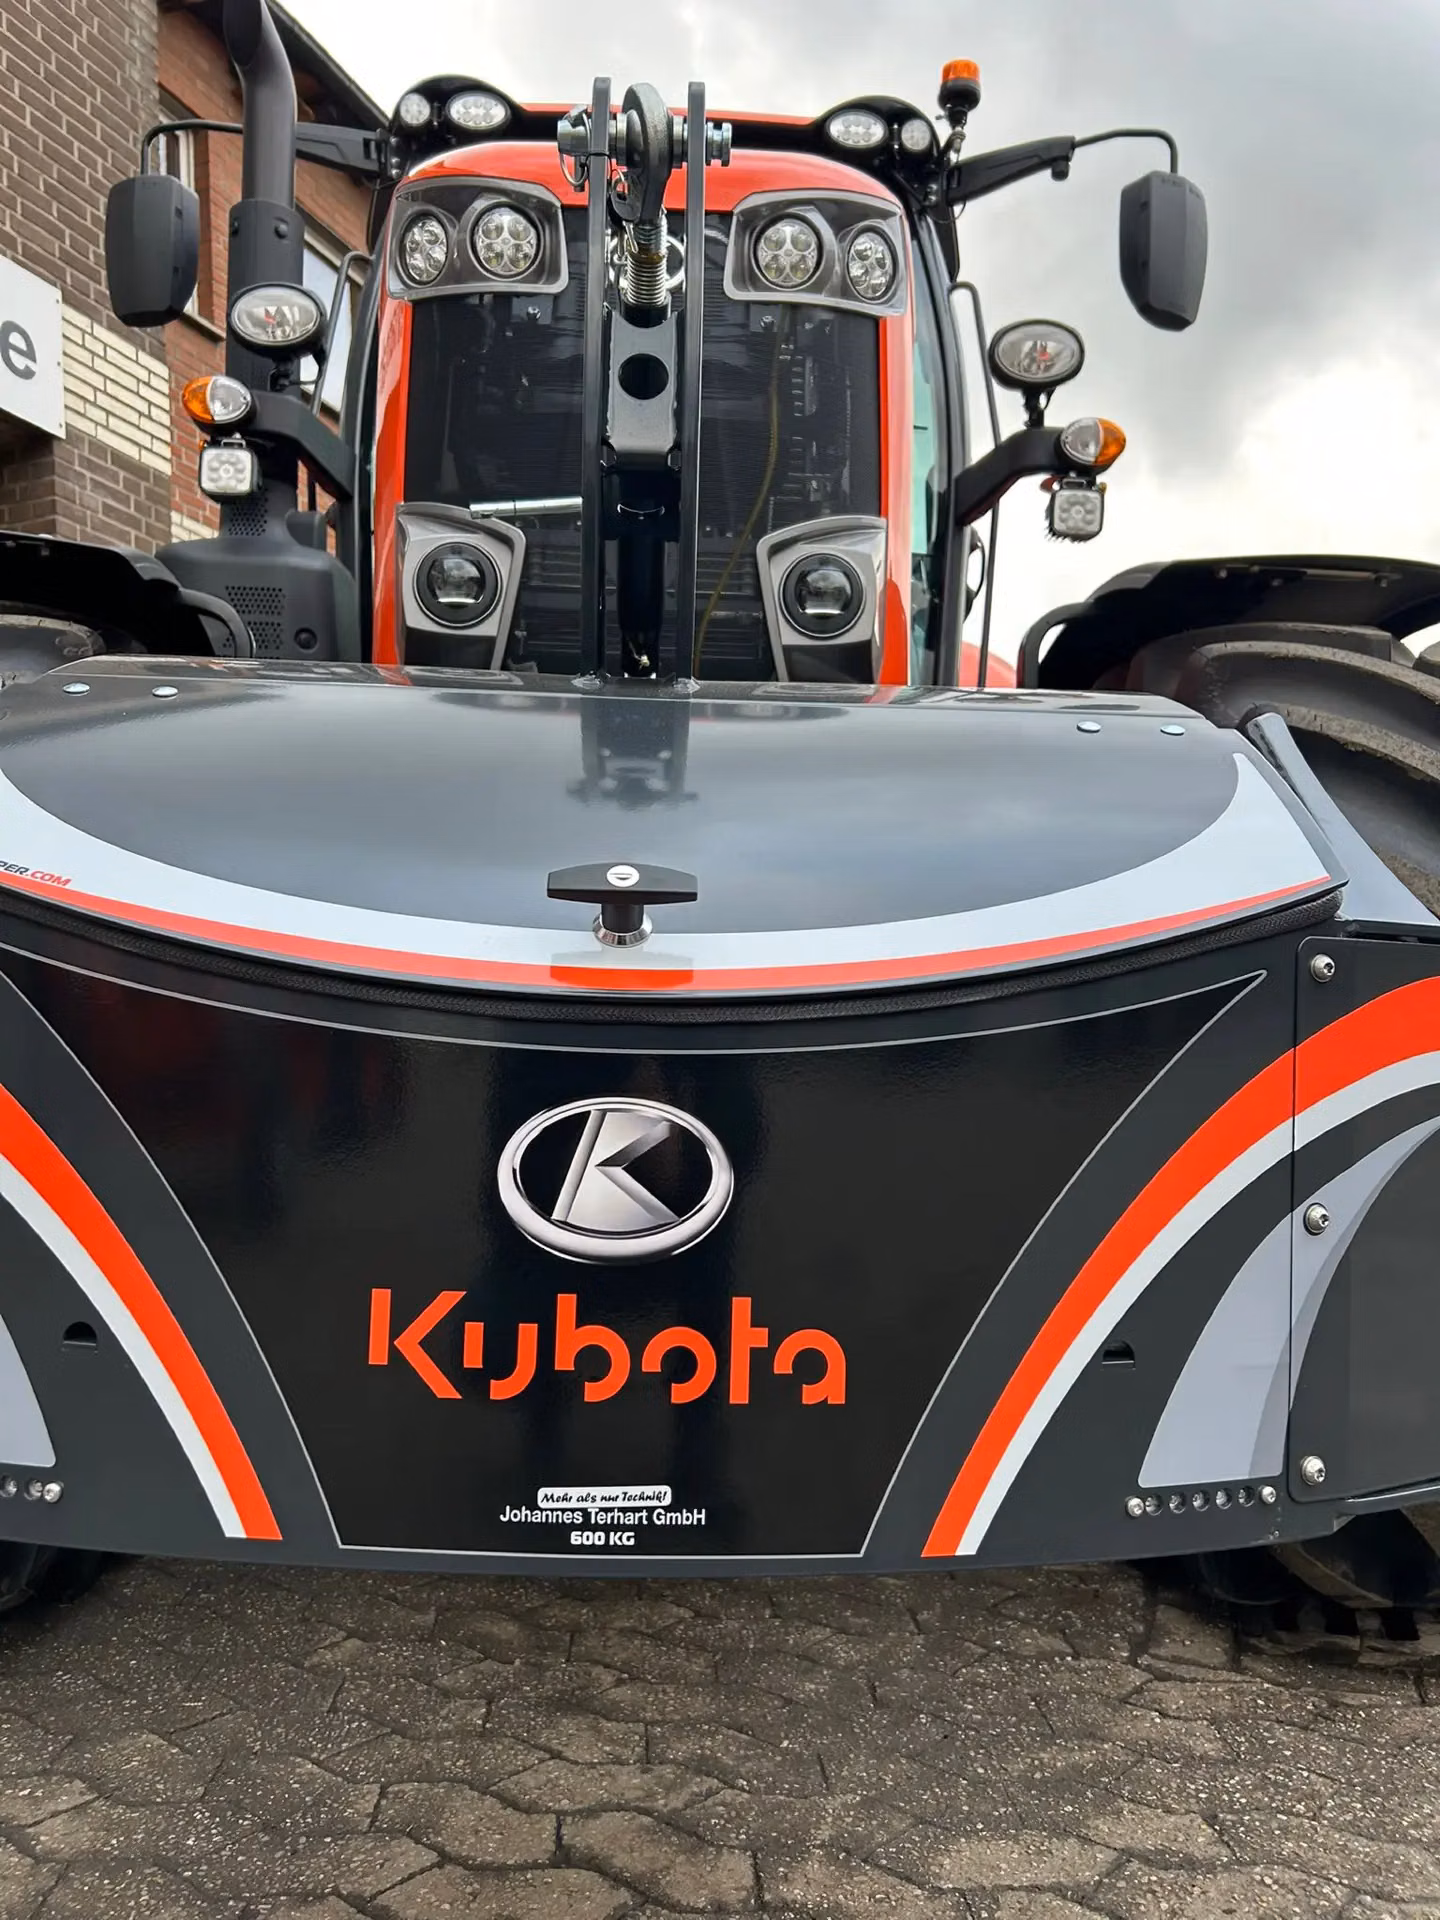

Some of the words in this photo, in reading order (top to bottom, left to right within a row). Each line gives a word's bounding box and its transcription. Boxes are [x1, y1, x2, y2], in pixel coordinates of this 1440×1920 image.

[368, 1288, 847, 1405] Kubota
[541, 1492, 573, 1504] Mehr
[576, 1492, 597, 1504] als
[600, 1493, 620, 1503] nur
[621, 1490, 668, 1504] Technik!
[499, 1505, 583, 1524] Johannes
[588, 1507, 648, 1525] Terhart
[652, 1508, 706, 1525] GmbH
[570, 1531, 606, 1546] 600
[609, 1531, 635, 1546] KG
